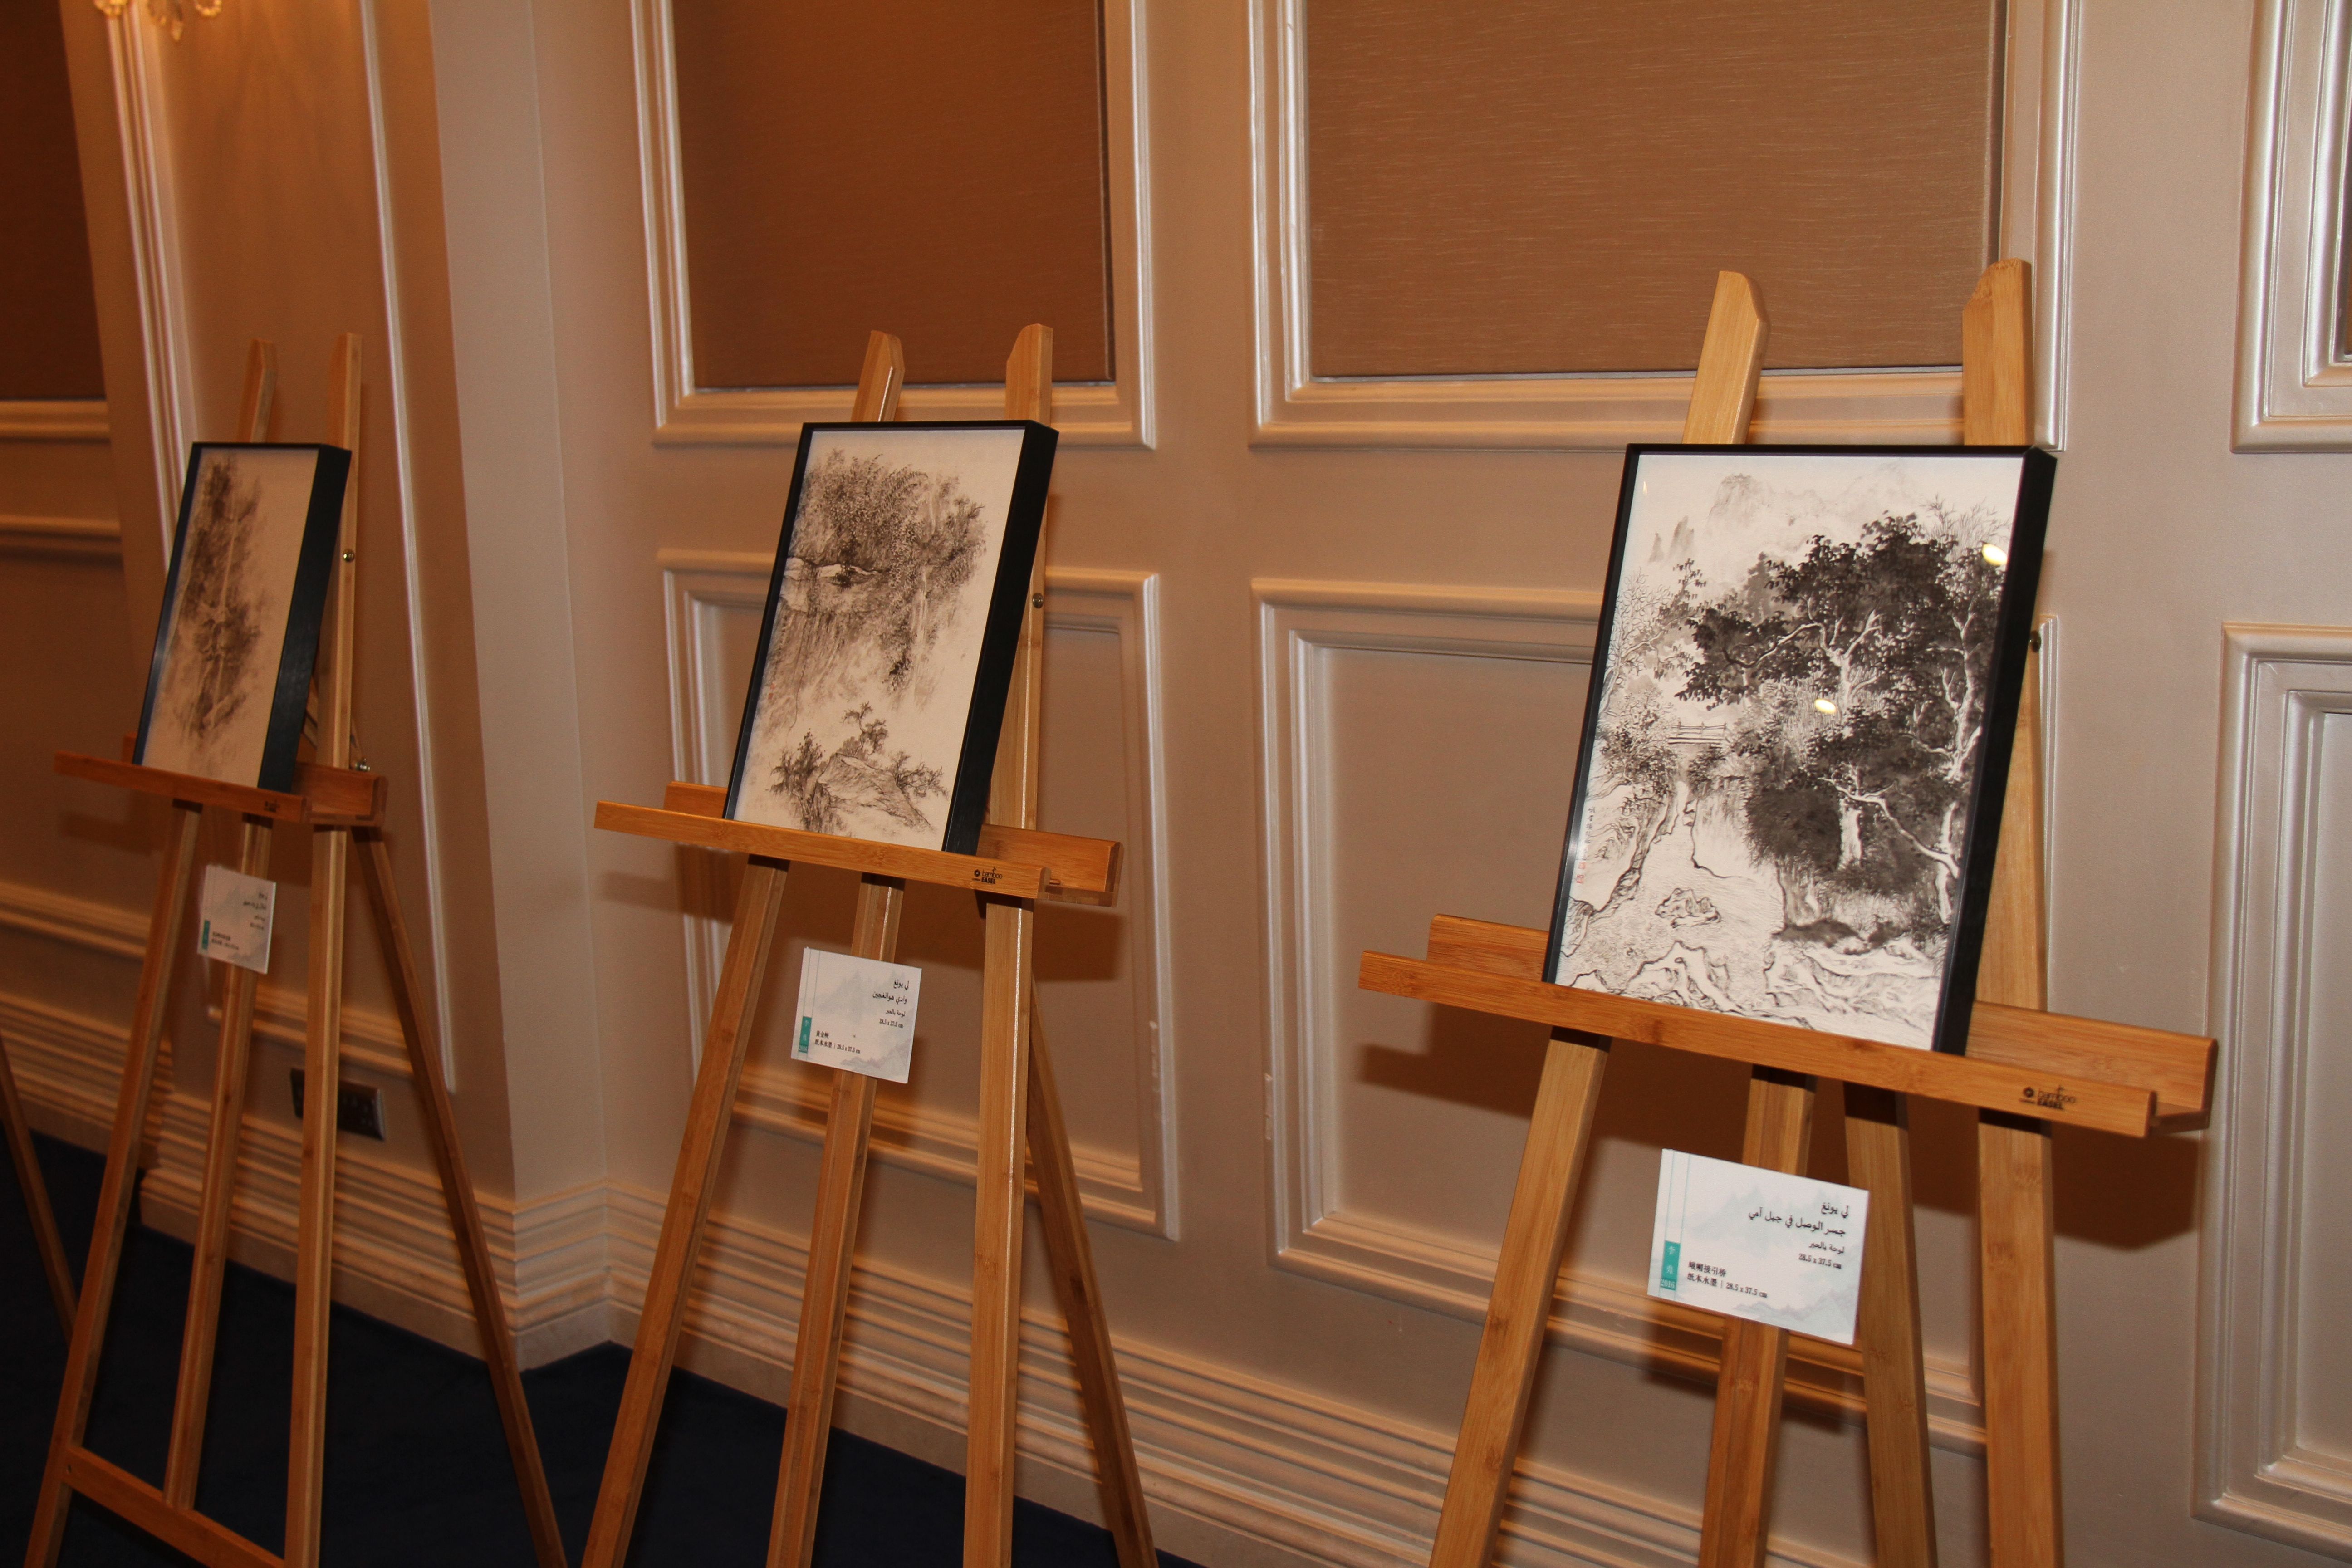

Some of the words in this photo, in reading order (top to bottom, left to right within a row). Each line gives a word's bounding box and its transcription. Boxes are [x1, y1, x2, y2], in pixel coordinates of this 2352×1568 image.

[1821, 1202, 1838, 1215] يونغ
[1841, 1205, 1849, 1219] لي
[1765, 1211, 1782, 1223] جبل
[1785, 1215, 1793, 1228] في
[1795, 1217, 1823, 1231] الوصل
[1824, 1228, 1846, 1237] جسر
[1829, 1244, 1844, 1254] لوحة
[1798, 1253, 1812, 1262] 28.5
[1818, 1257, 1832, 1266] 37.5
[1687, 1273, 1717, 1286] 纸本水墨
[1726, 1282, 1738, 1291] 28.5
[1745, 1286, 1758, 1295] 37.5
